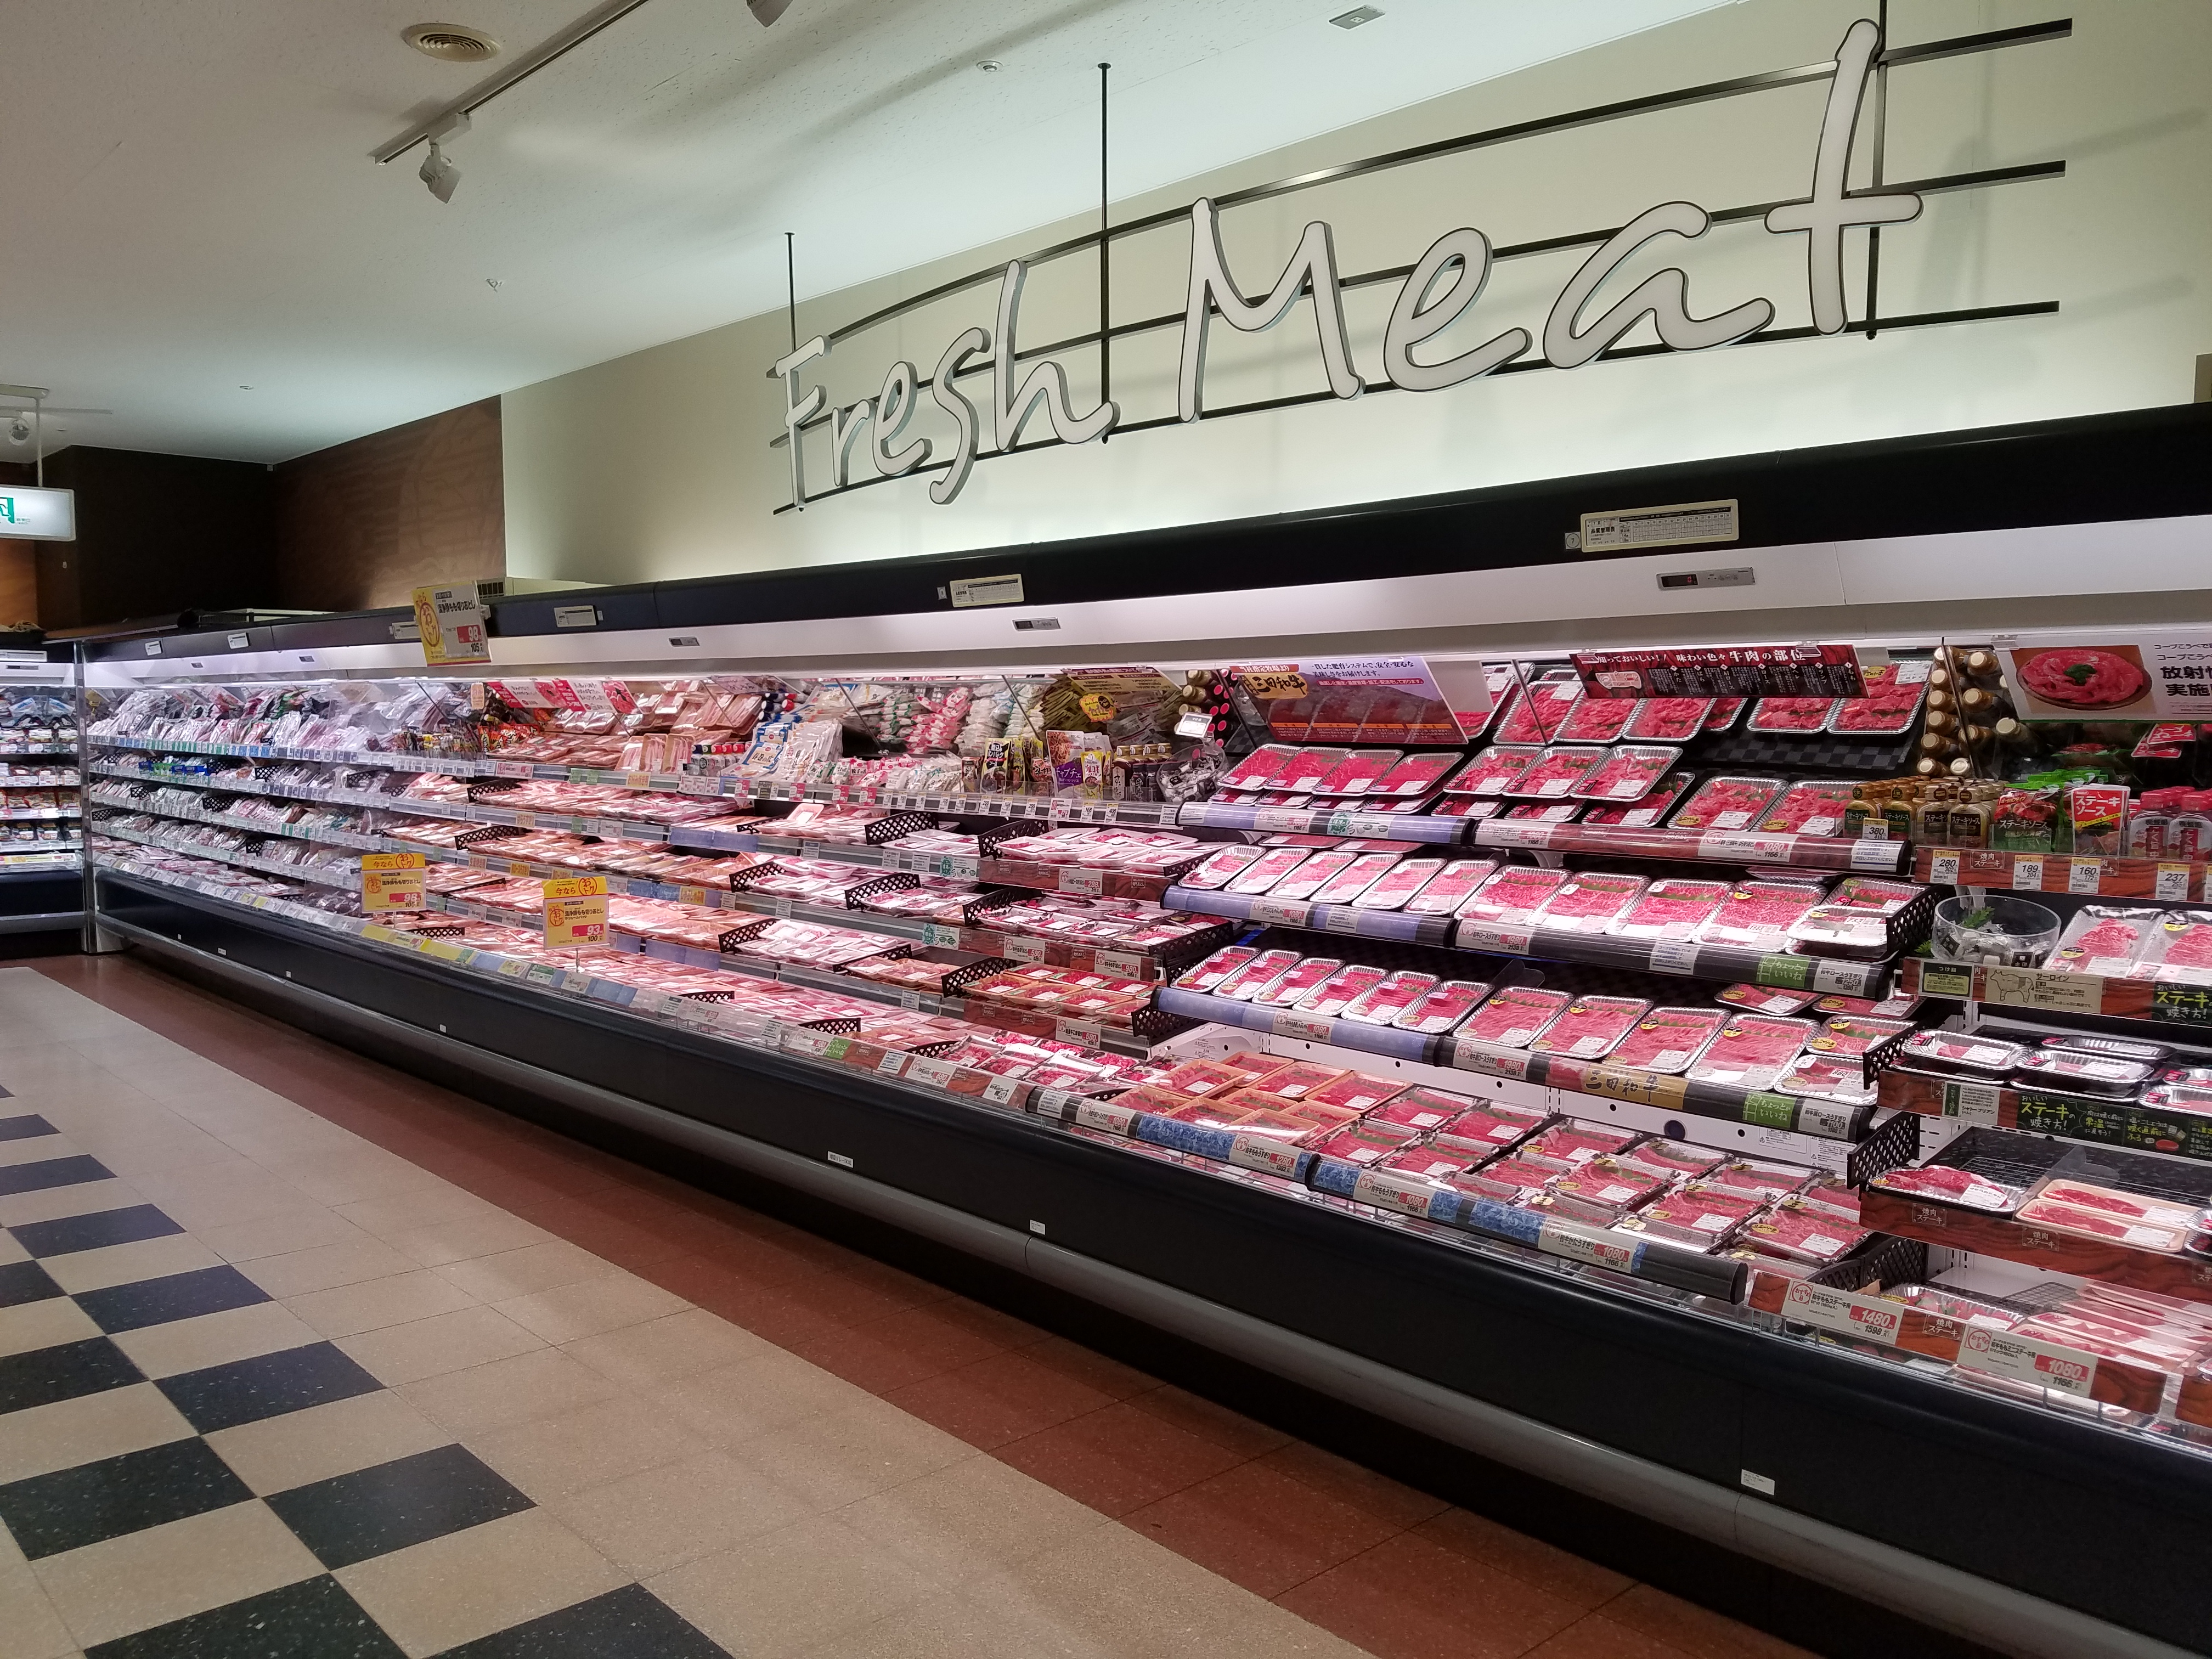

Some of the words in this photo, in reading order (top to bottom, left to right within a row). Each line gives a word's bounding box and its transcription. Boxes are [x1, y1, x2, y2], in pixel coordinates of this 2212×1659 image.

[775, 260, 1119, 509] Fresh
[1180, 19, 1923, 424] Meat
[468, 626, 479, 641] 98
[471, 642, 480, 652] 105
[1252, 674, 1307, 695] 三田和牛
[2165, 683, 2212, 696] 実施
[1056, 766, 1082, 779] チャプチェ
[2075, 795, 2121, 808] ステーキ
[2076, 805, 2107, 816] ソース
[1884, 812, 1910, 821] ステーキソース
[1951, 816, 1980, 825] ステーキソース
[1999, 820, 2048, 829] ステーキソース
[1869, 827, 1884, 836] 380
[1763, 842, 1784, 851] 1080
[1939, 859, 1956, 867] 280
[2022, 864, 2039, 873] 189
[2079, 866, 2097, 875] 160
[2165, 873, 2186, 882] 237
[556, 887, 576, 895] 今なら
[404, 893, 418, 902] 98
[587, 924, 601, 935] 93
[1507, 935, 1524, 945] 1980
[1125, 964, 1137, 973] 980
[1774, 970, 1802, 981] いいね
[1820, 969, 1863, 979] 和牛ロースうすぎり
[2036, 972, 2070, 981] サーロイン
[1313, 1025, 1327, 1035] 1080
[1504, 1060, 1521, 1070] 1980
[935, 1072, 947, 1081] 680
[1585, 1070, 1659, 1103] 三田和牛
[1760, 1109, 1787, 1121] いいね
[1961, 1105, 1996, 1115] シャトーブリアン
[2021, 1102, 2076, 1121] ステーキの
[1826, 1120, 1843, 1128] 1100
[2085, 1117, 2105, 1129] 常温
[2128, 1125, 2167, 1137] 焼く直前に
[1276, 1155, 1291, 1166] 1280
[1371, 1185, 1400, 1199] 和牛ももうすぎり
[1406, 1194, 1424, 1207] 1080
[1407, 1205, 1419, 1213] 1166
[1921, 1207, 1937, 1216] 焼肉
[1916, 1214, 1943, 1224] ステーキ
[2033, 1231, 2049, 1240] 焼肉
[1559, 1234, 1595, 1250] 和牛かたうすぎり
[2026, 1238, 2056, 1248] ステーキ
[1603, 1246, 1625, 1260] 1080
[1605, 1257, 1619, 1266] 1166
[1812, 1294, 1852, 1309] 和牛ももステーキ用
[1936, 1318, 1953, 1328] 焼肉
[1928, 1324, 1958, 1337] ステーキ
[2049, 1359, 2083, 1379] 1080
[2053, 1376, 2073, 1387] 1166
